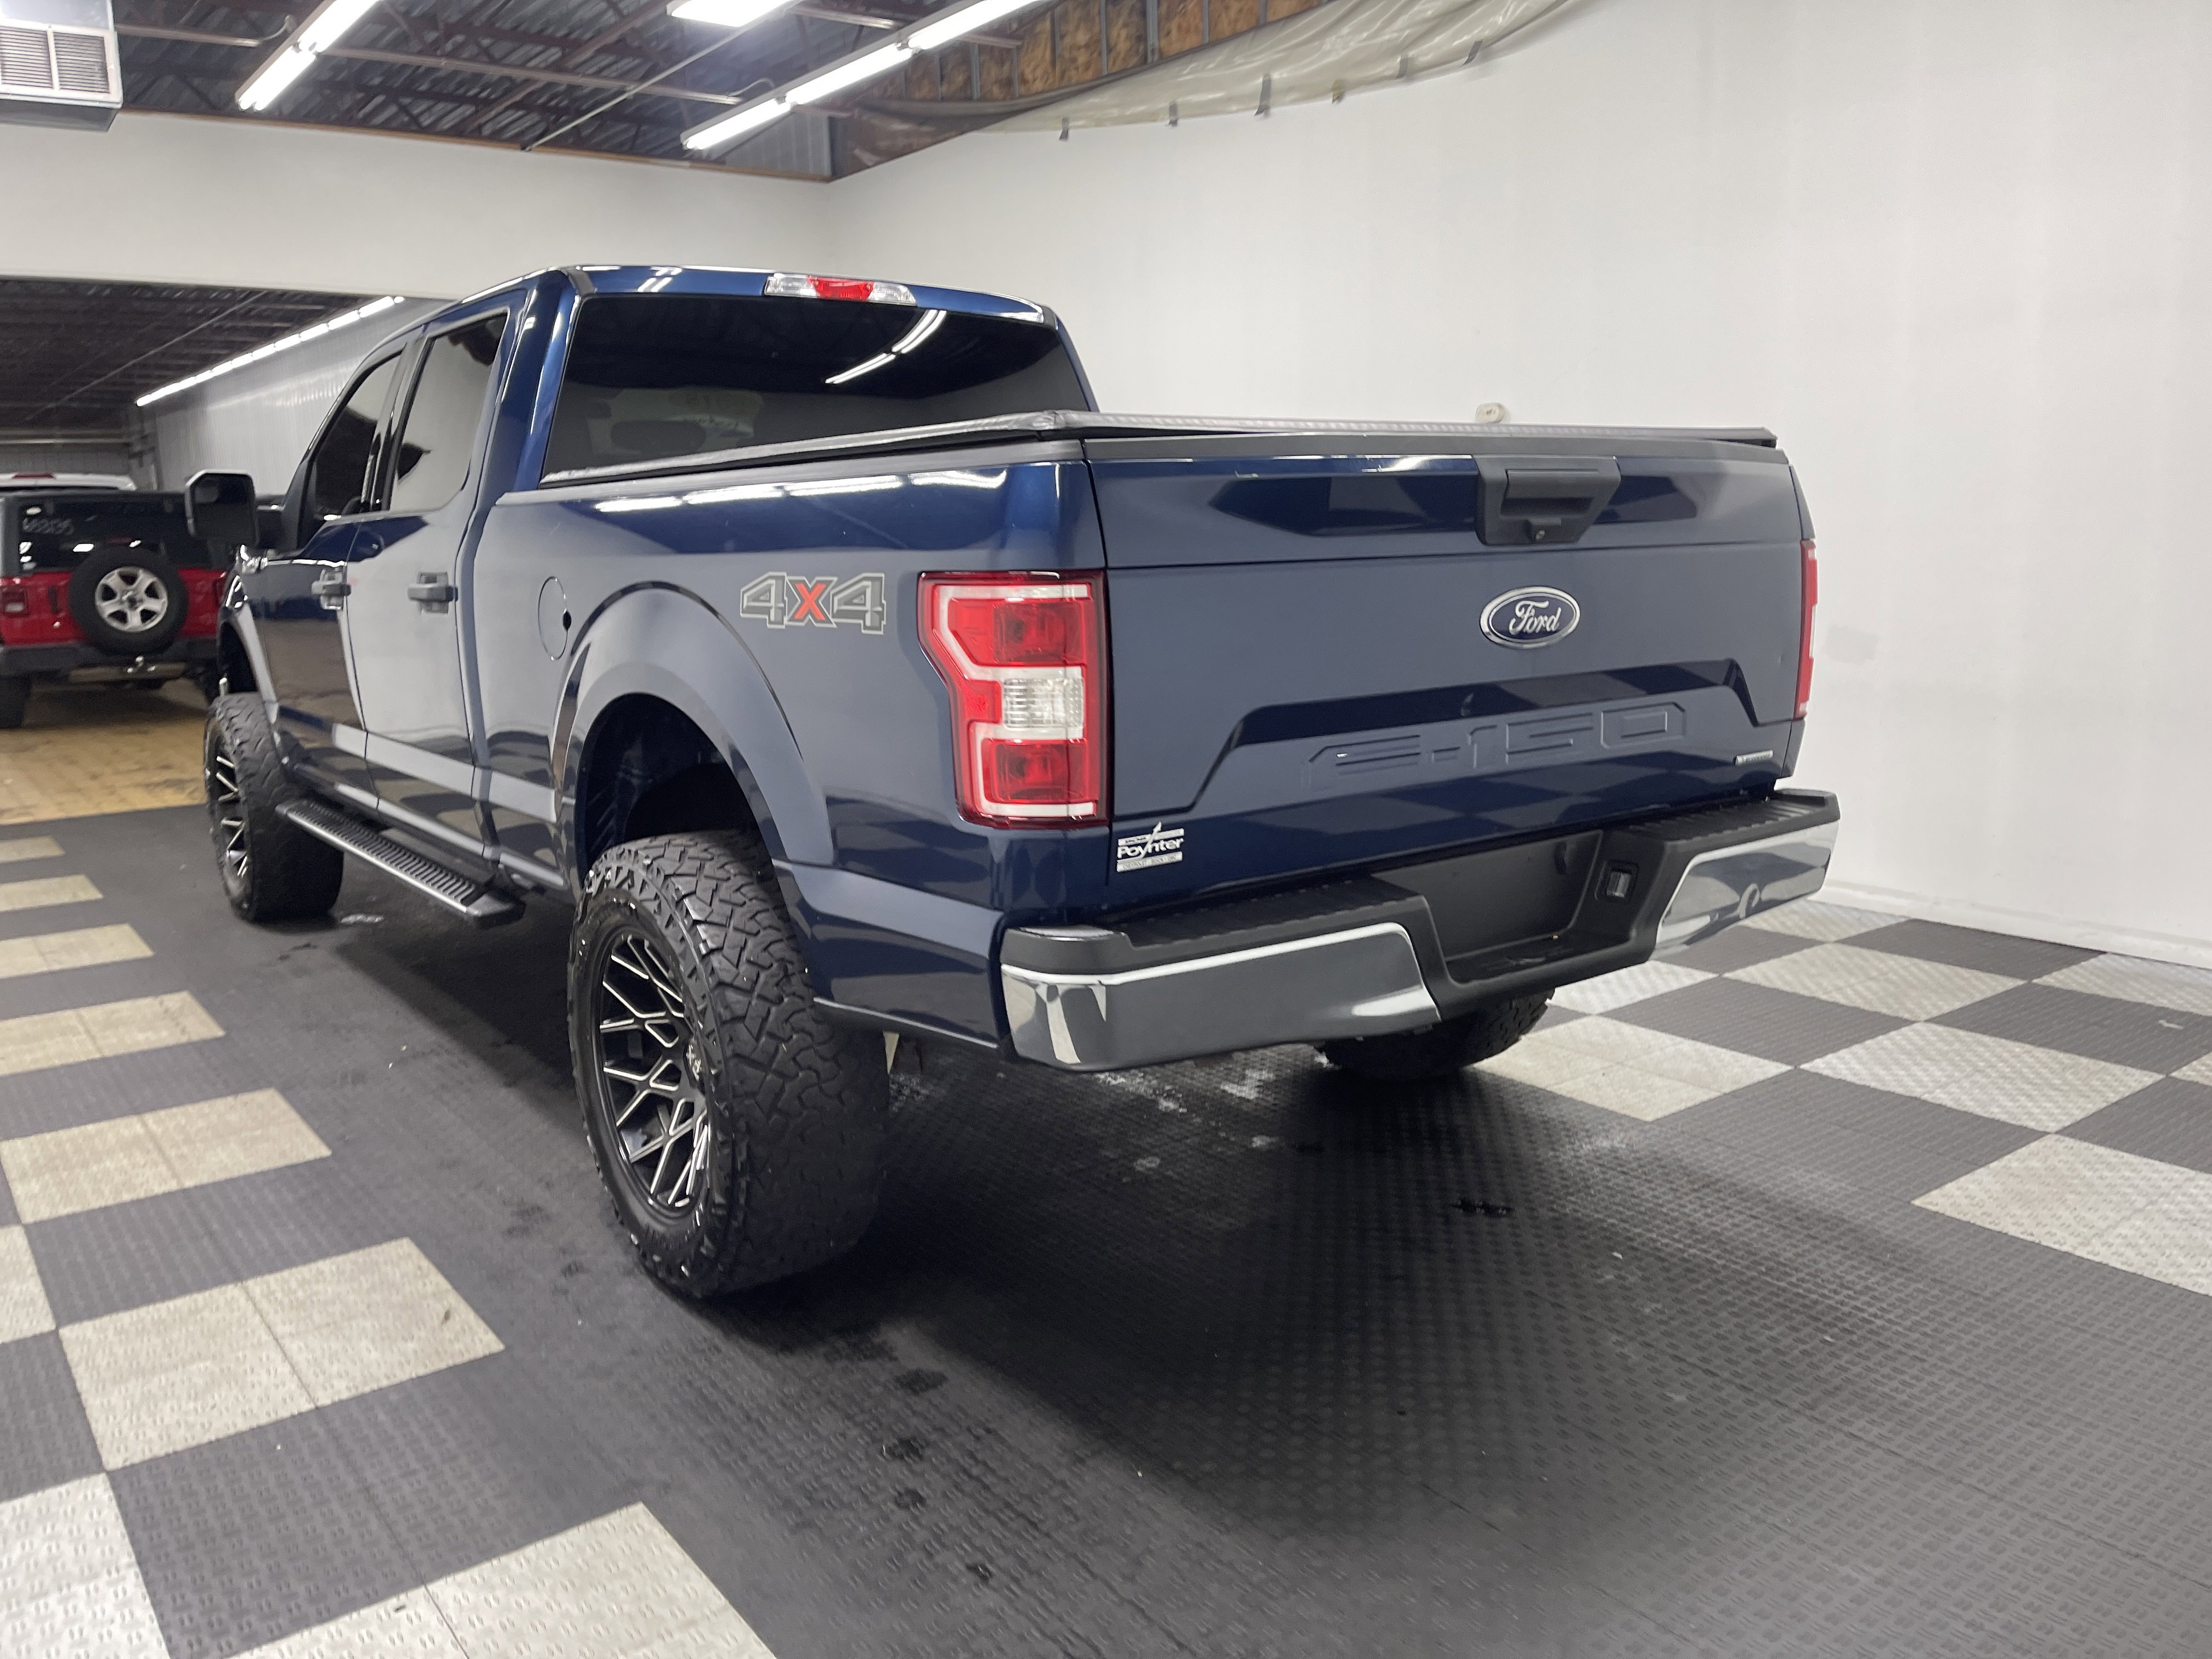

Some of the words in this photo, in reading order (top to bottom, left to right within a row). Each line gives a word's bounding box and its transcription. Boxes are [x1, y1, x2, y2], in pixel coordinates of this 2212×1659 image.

[1509, 600, 1562, 635] Ford
[1300, 702, 1686, 793] F-150
[1117, 837, 1184, 859] Poynter
